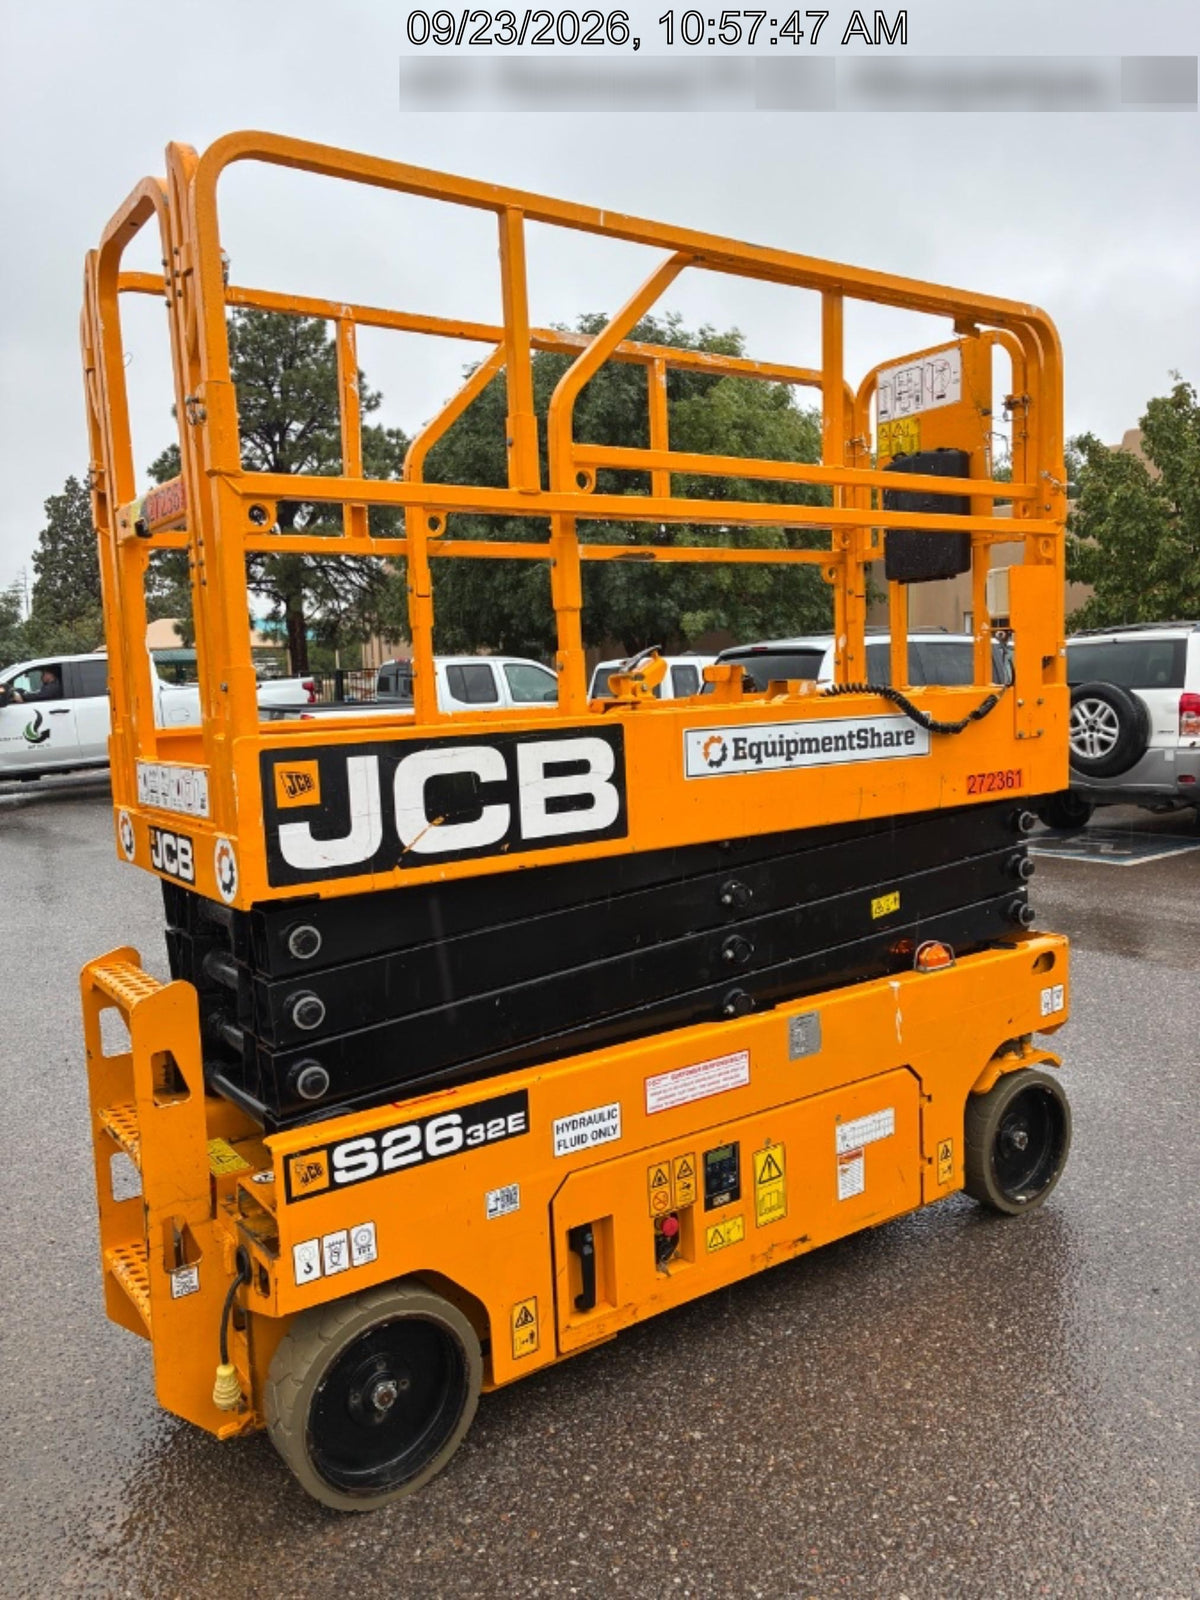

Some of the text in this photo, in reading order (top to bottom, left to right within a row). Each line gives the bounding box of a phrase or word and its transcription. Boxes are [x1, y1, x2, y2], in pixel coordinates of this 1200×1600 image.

[731, 727, 916, 766] EquipmentShare
[283, 770, 313, 798] JCB
[967, 770, 1023, 795] 272361
[278, 737, 620, 870] JCB
[152, 831, 194, 881] JCB
[555, 1106, 619, 1135] HYDRAULIC
[556, 1124, 619, 1152] FLUID ONLY
